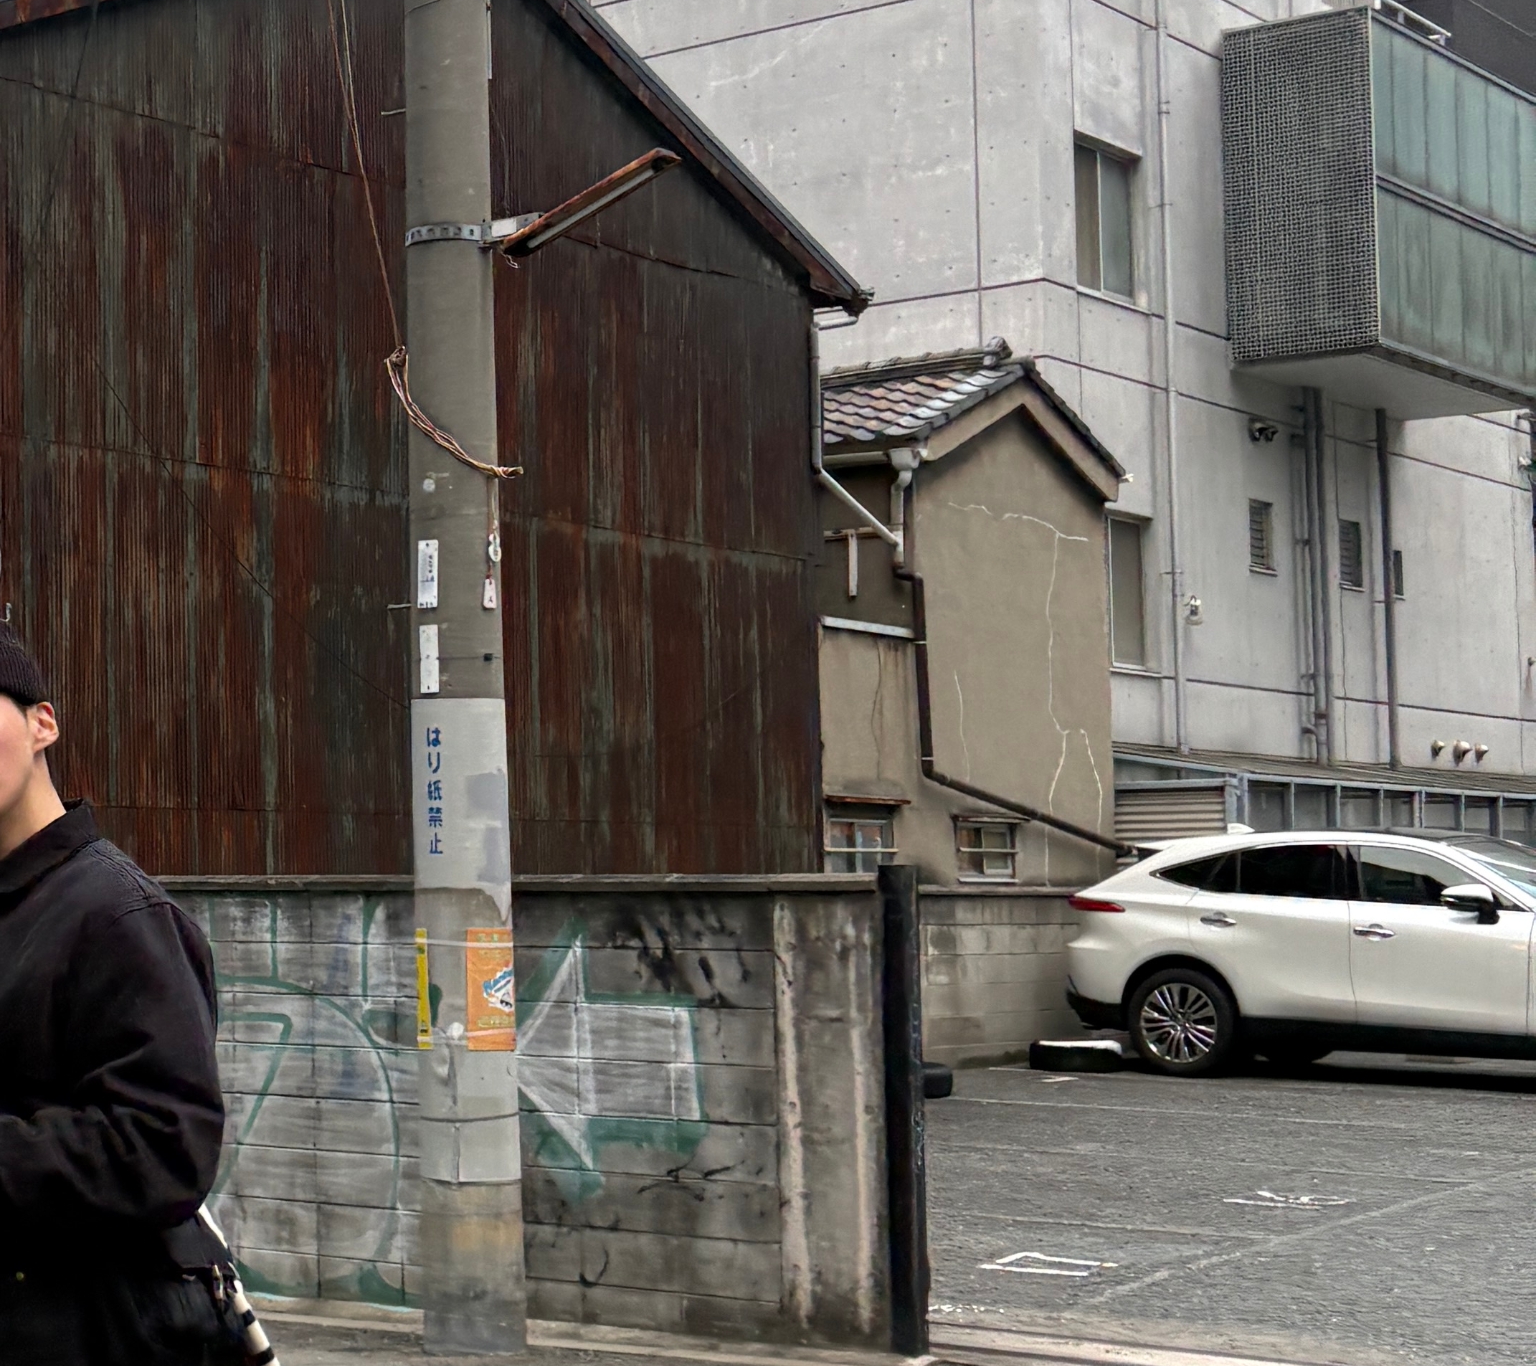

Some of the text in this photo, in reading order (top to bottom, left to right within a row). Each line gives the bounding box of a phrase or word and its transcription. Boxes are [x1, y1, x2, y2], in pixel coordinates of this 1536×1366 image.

[426, 726, 444, 855] はり紙禁止
